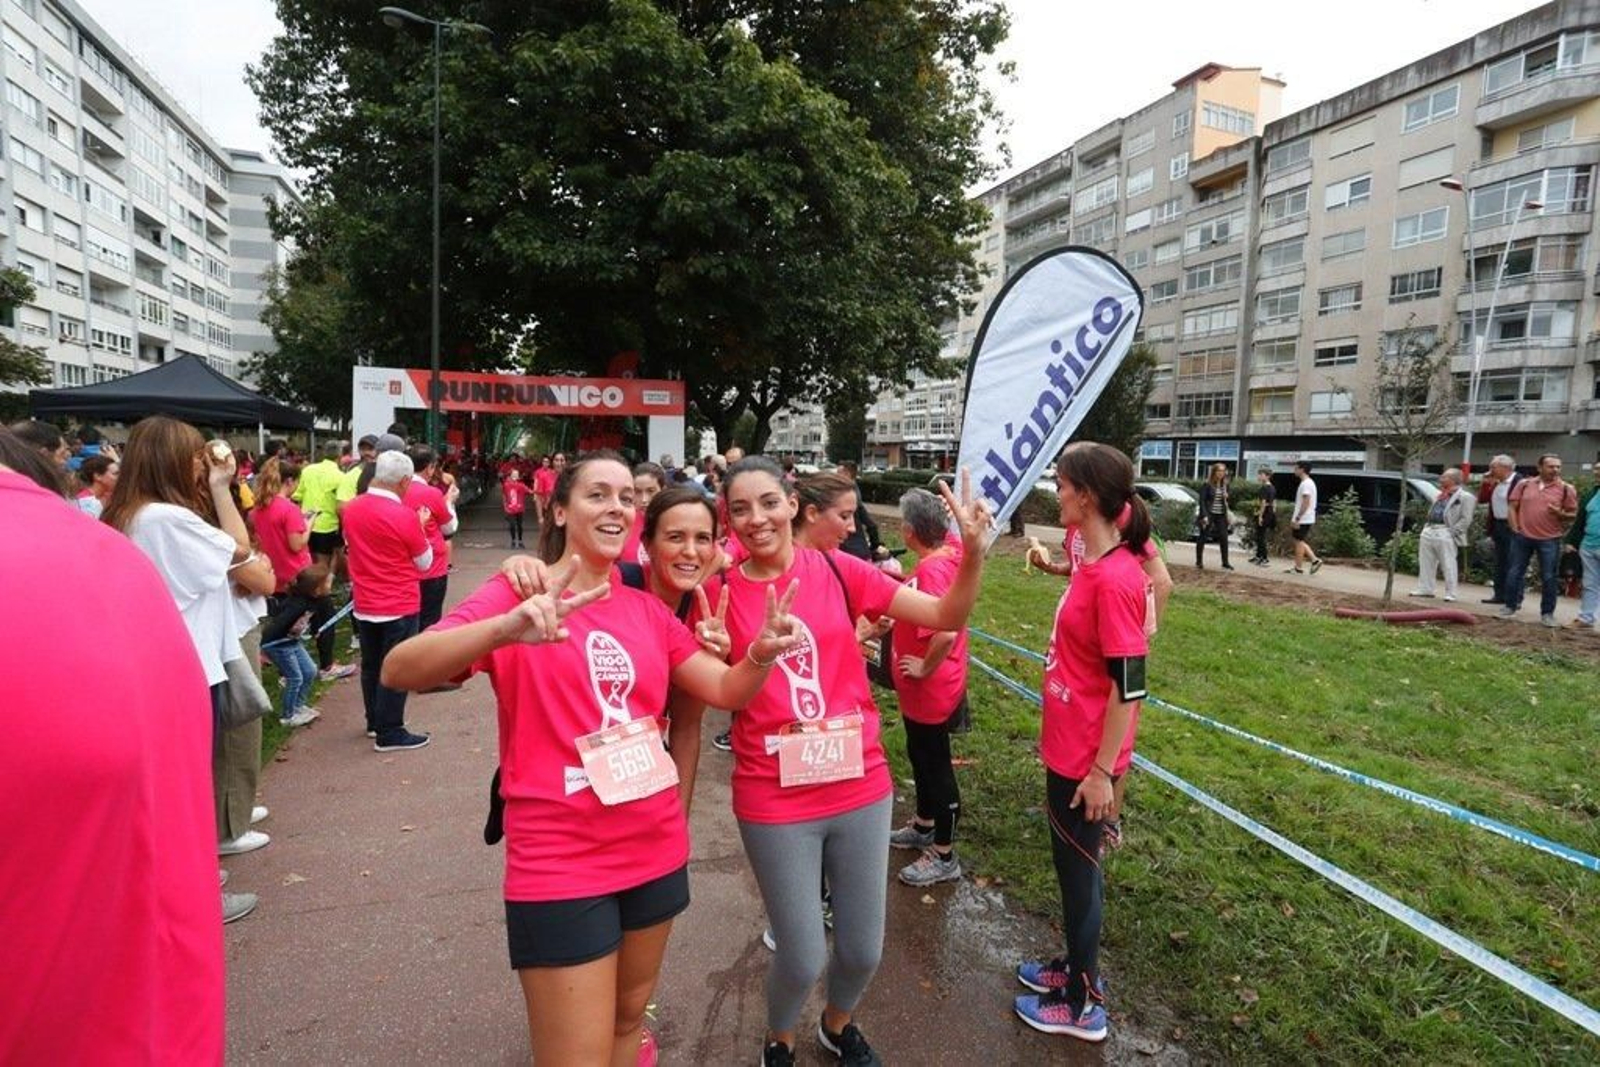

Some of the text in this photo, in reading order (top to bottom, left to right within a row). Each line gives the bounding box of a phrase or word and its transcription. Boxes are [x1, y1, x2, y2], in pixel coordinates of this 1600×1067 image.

[981, 296, 1123, 513] tlántico
[594, 655, 625, 667] VIGO
[606, 742, 656, 783] 5691
[800, 739, 845, 766] 4241
